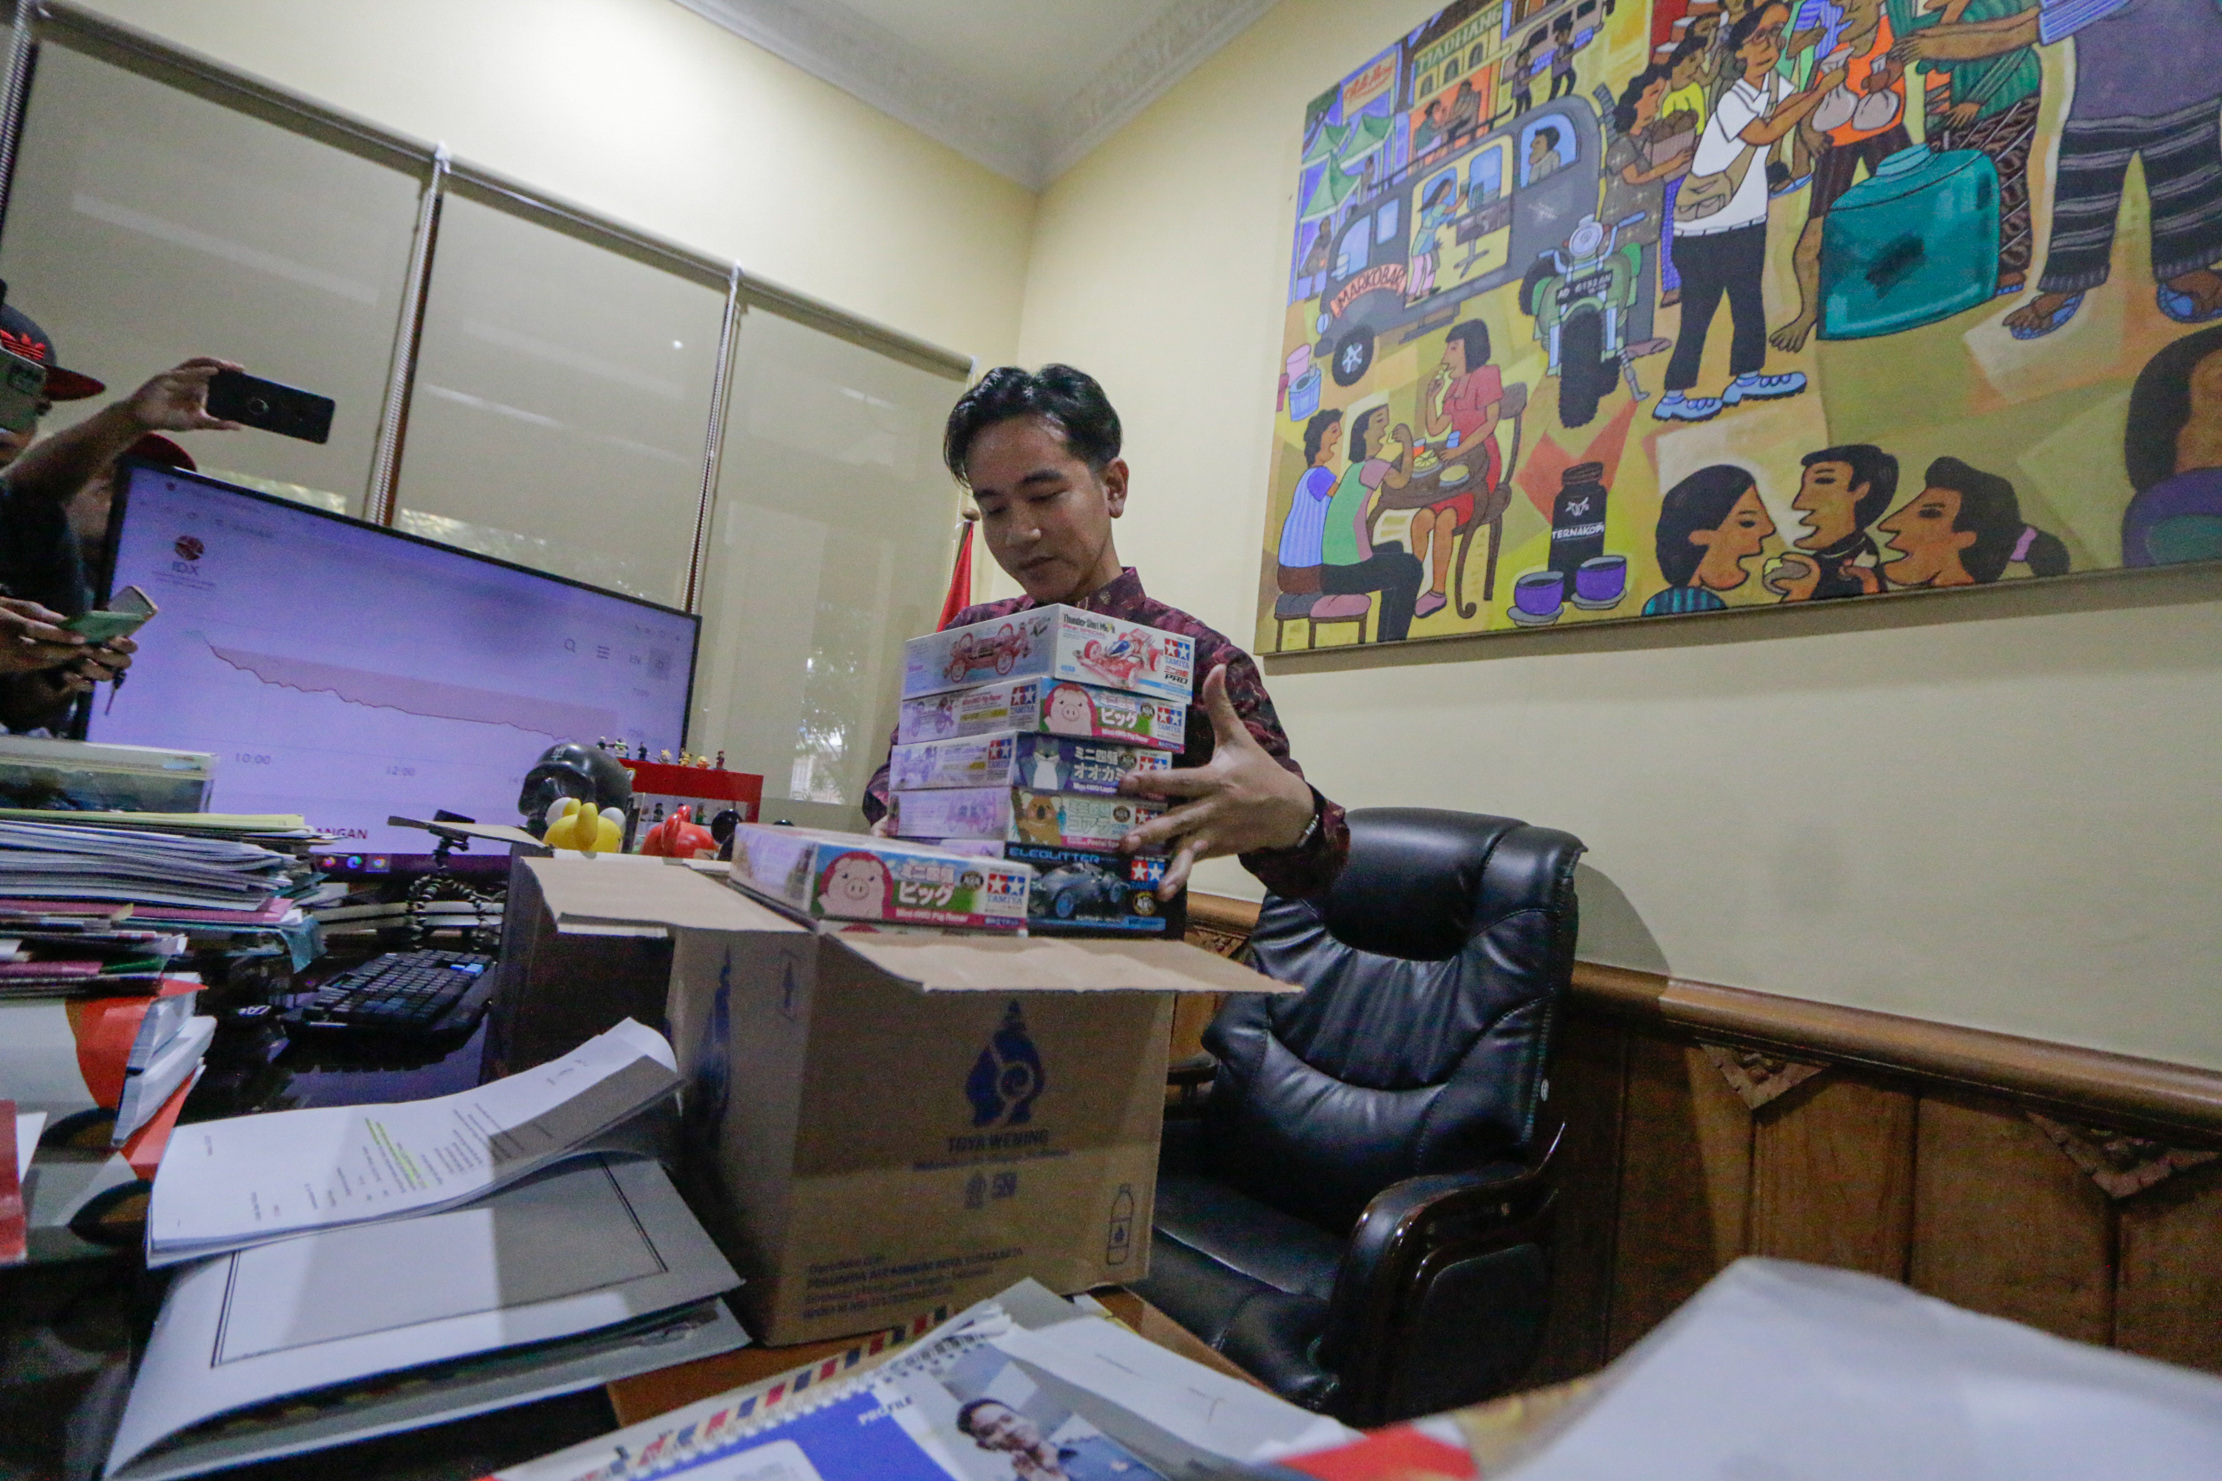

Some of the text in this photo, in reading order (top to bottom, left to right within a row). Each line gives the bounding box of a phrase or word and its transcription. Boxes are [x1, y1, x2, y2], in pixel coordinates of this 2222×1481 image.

[1552, 523, 1605, 540] TERNAKOPI
[171, 560, 200, 576] IDX
[1165, 656, 1190, 669] TAMIYA
[1165, 674, 1188, 685] PRO
[235, 752, 271, 765] 10:00
[1073, 762, 1127, 782] オオカミ
[1008, 847, 1101, 863] ELEGLITTER
[986, 893, 1023, 905] TAMIYA
[948, 1133, 985, 1153] TOYA
[858, 1396, 913, 1426] PROFILE
